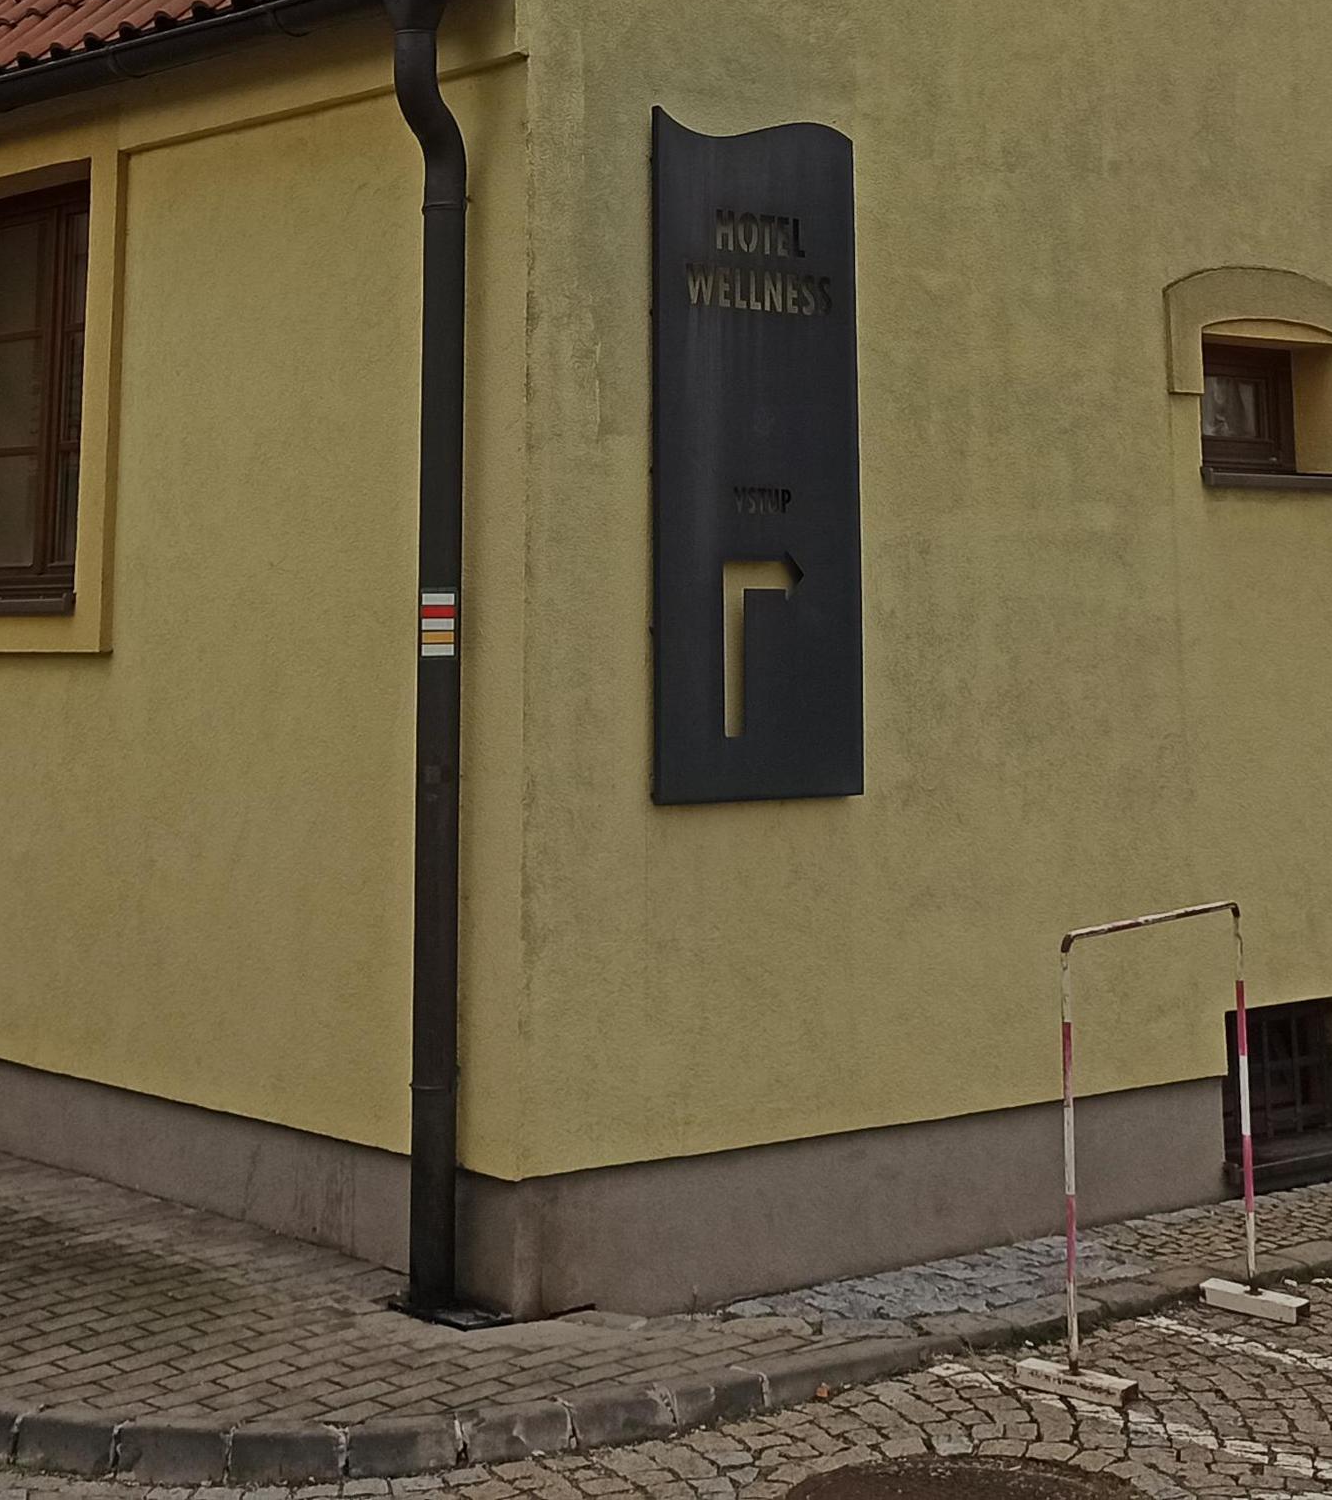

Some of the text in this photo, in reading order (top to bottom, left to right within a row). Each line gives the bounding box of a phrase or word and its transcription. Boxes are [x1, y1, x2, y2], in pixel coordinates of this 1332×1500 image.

[715, 209, 806, 258] HOTEL
[686, 261, 833, 317] WELLNESS
[732, 486, 793, 515] VSTUP
